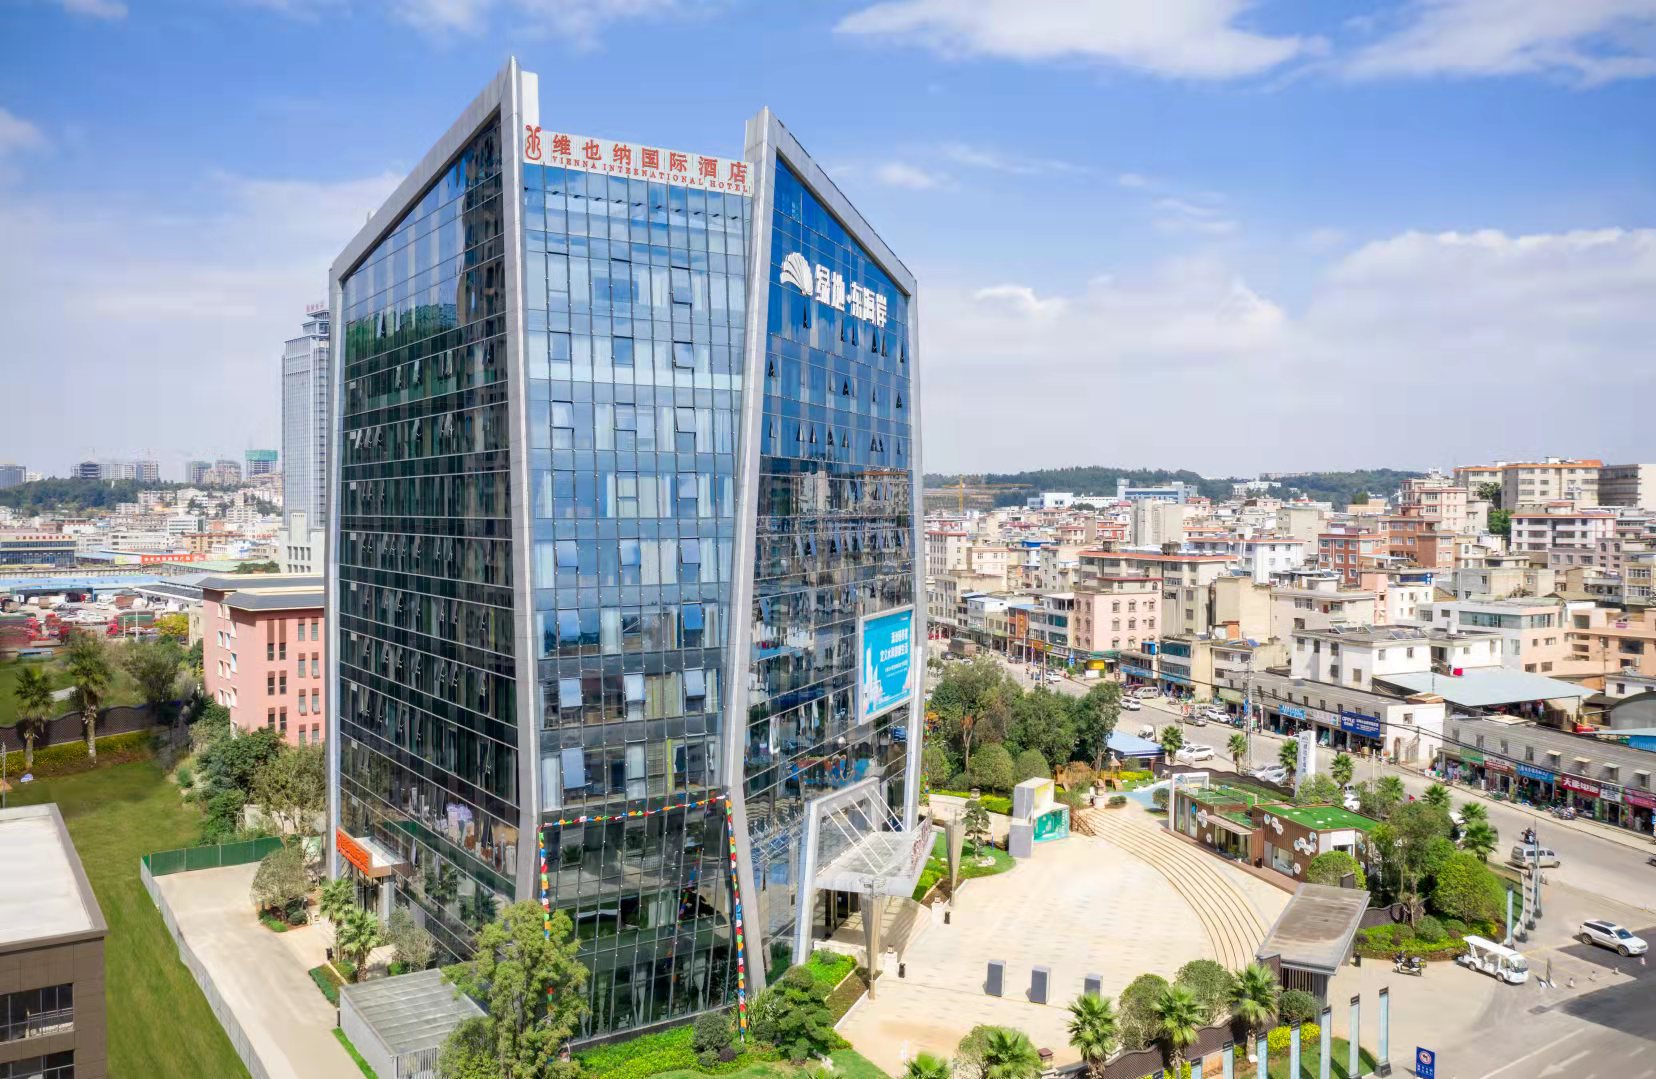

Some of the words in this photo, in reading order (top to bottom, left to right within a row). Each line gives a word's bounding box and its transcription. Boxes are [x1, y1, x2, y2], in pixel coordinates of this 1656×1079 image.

[552, 133, 748, 184] 维也纳国际酒店
[552, 155, 597, 169] VIENNA
[603, 162, 704, 185] INTERNATIONAL
[709, 180, 748, 193] HOTEL
[815, 263, 887, 328] 绿地·东海岸
